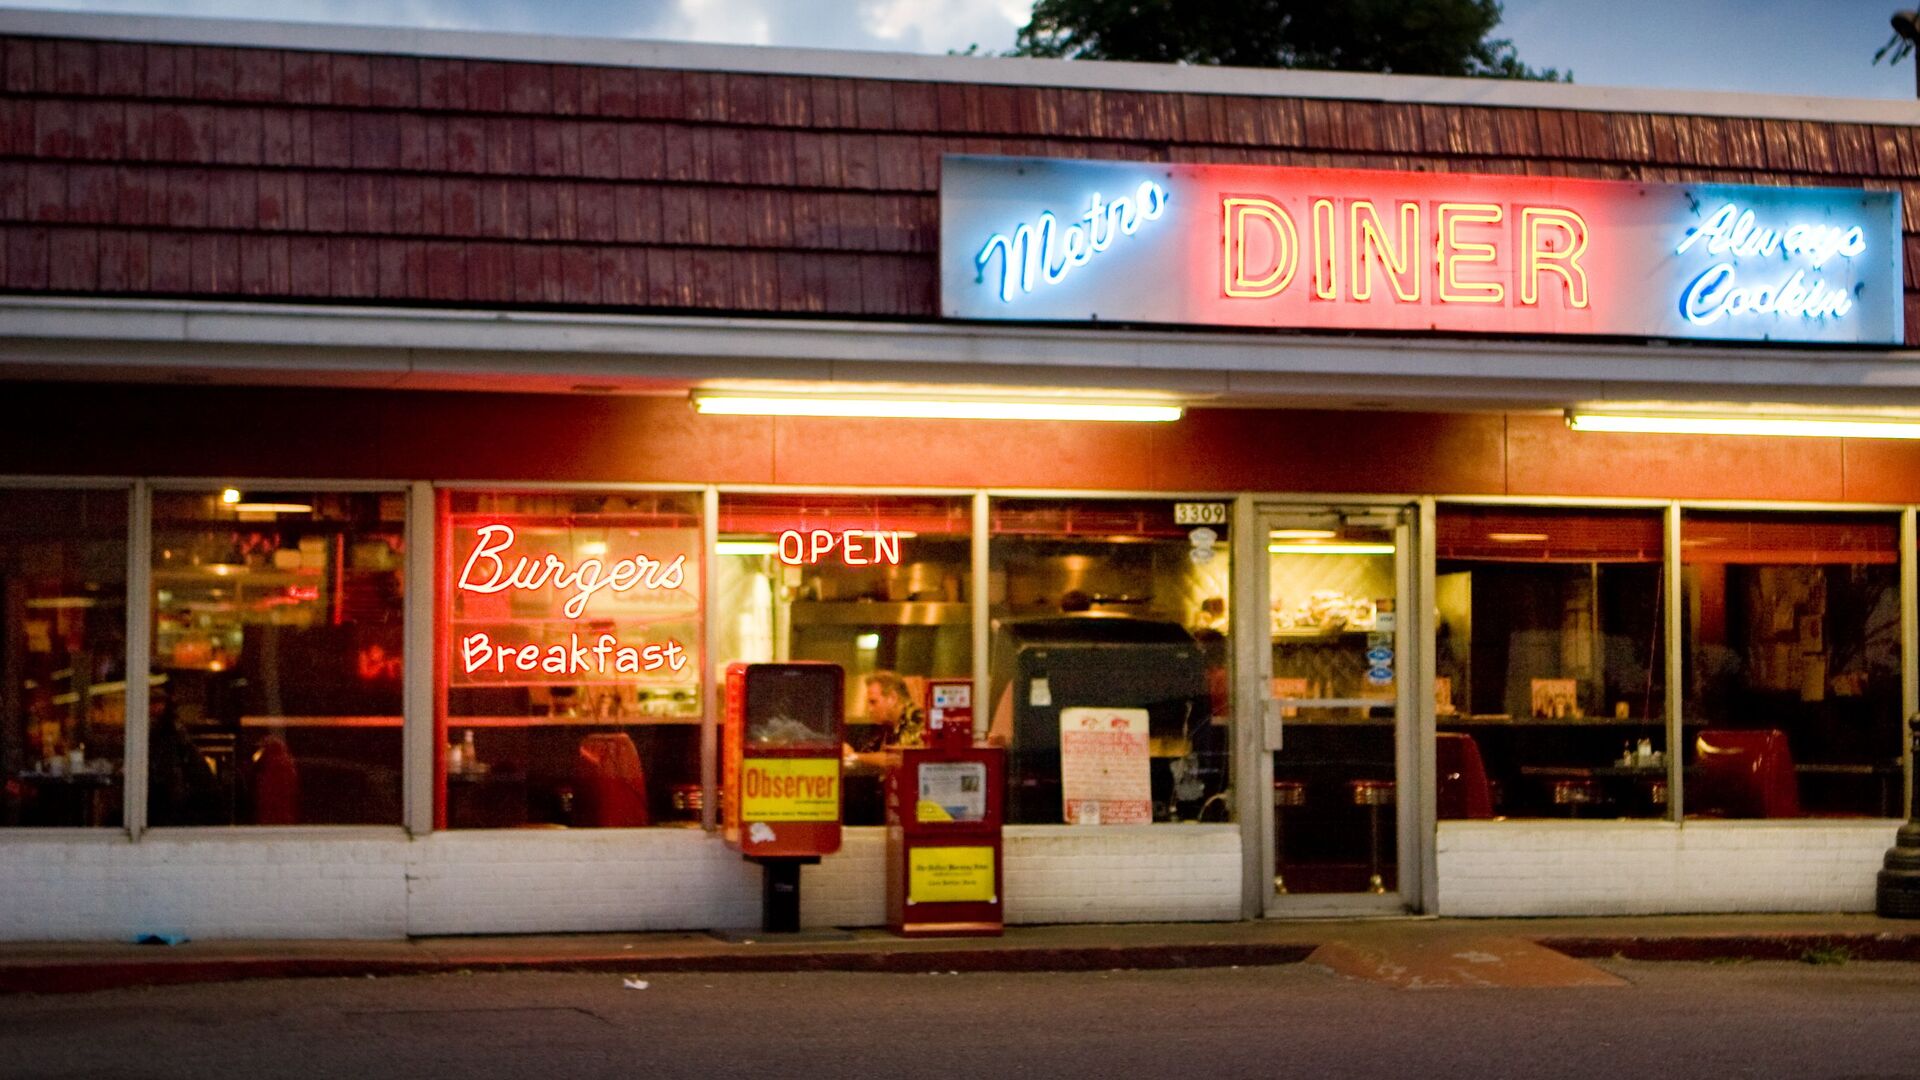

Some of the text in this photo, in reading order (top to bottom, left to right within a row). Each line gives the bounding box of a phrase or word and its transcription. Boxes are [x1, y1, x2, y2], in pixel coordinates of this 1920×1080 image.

[977, 179, 1589, 308] Metro DINER
[1676, 203, 1866, 267] Always
[1680, 262, 1853, 326] Cookin
[1178, 504, 1224, 523] 3309
[458, 524, 686, 619] Burgers
[779, 529, 900, 565] OPEN
[462, 632, 687, 674] Breakfast
[746, 768, 836, 799] Observer
